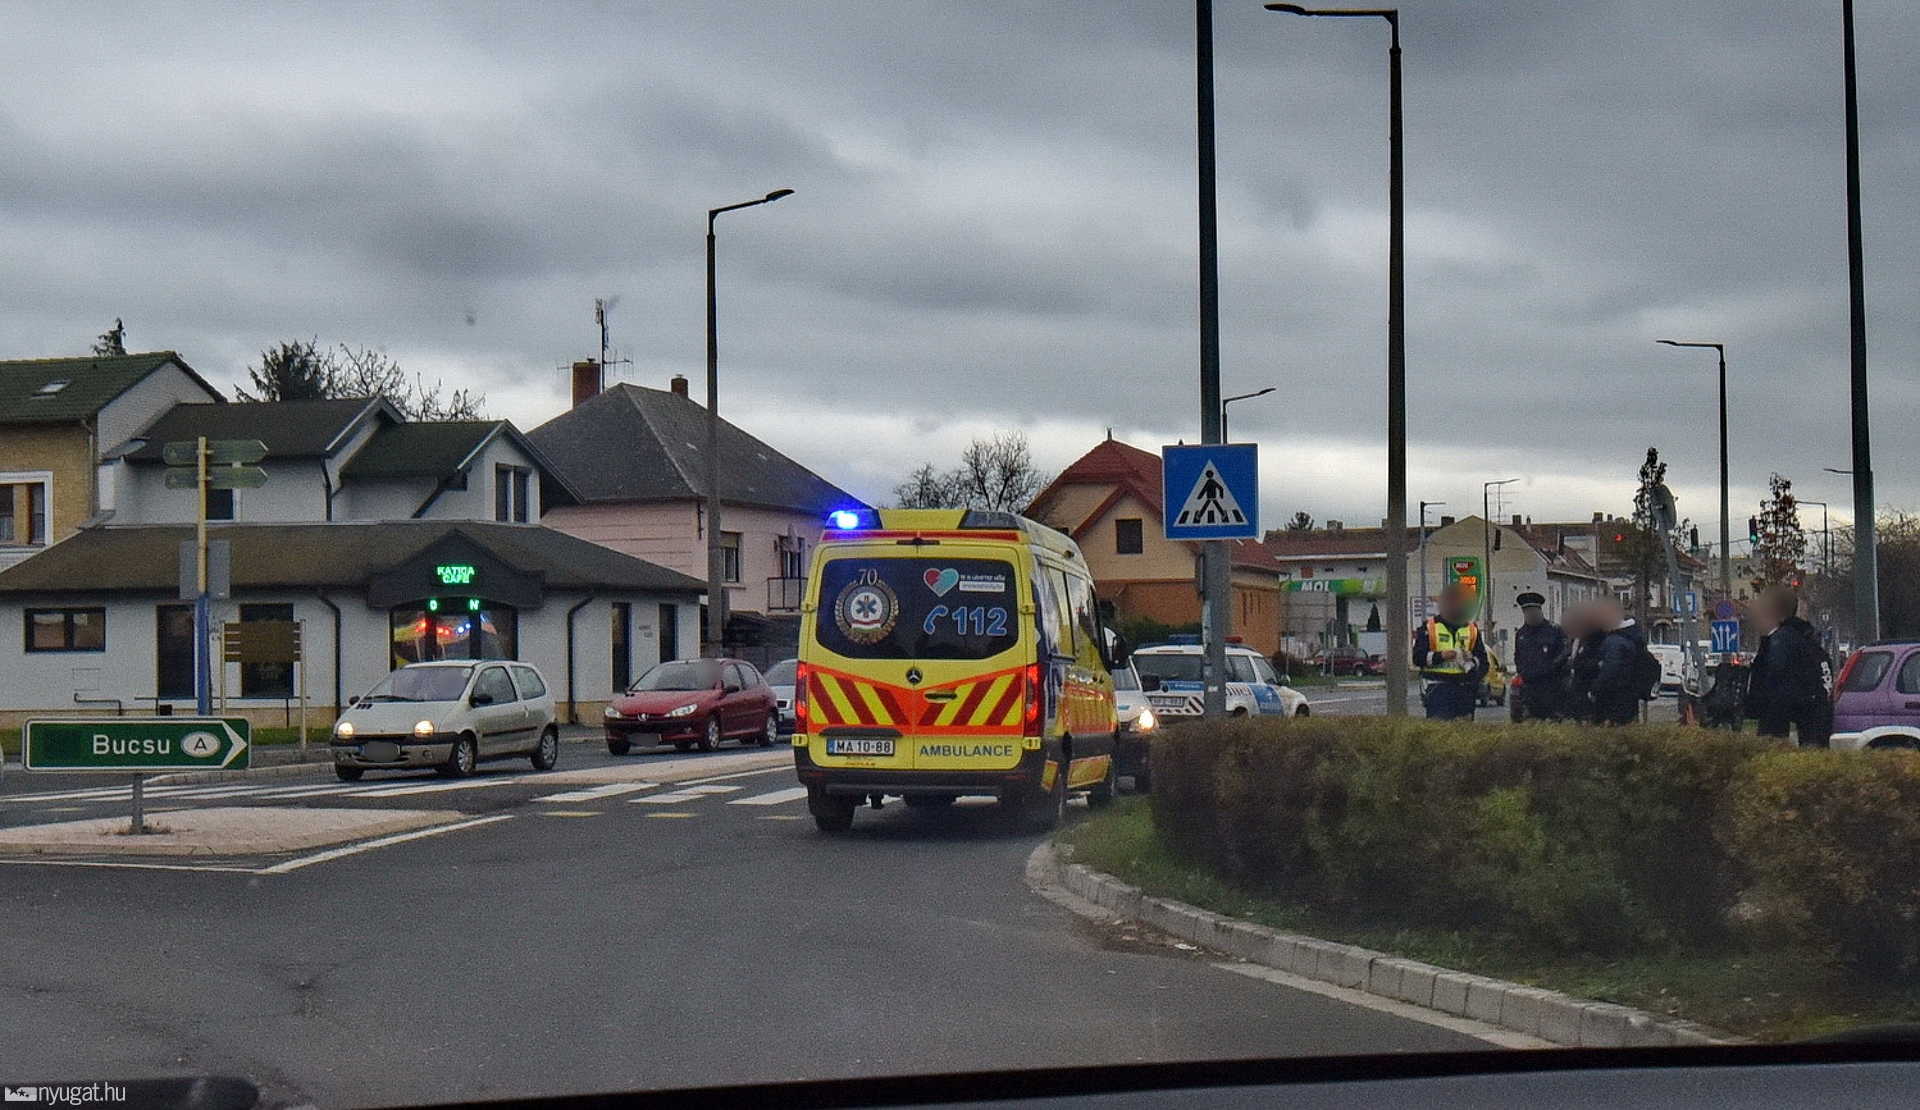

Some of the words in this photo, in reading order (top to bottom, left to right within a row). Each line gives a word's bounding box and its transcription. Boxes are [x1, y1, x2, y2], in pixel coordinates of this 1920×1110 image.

[858, 568, 878, 585] 70
[951, 606, 1008, 636] 112
[92, 734, 171, 755] Bucsu
[836, 740, 854, 753] MA
[857, 740, 891, 753] 10-88
[919, 744, 1013, 758] AMBULANCE
